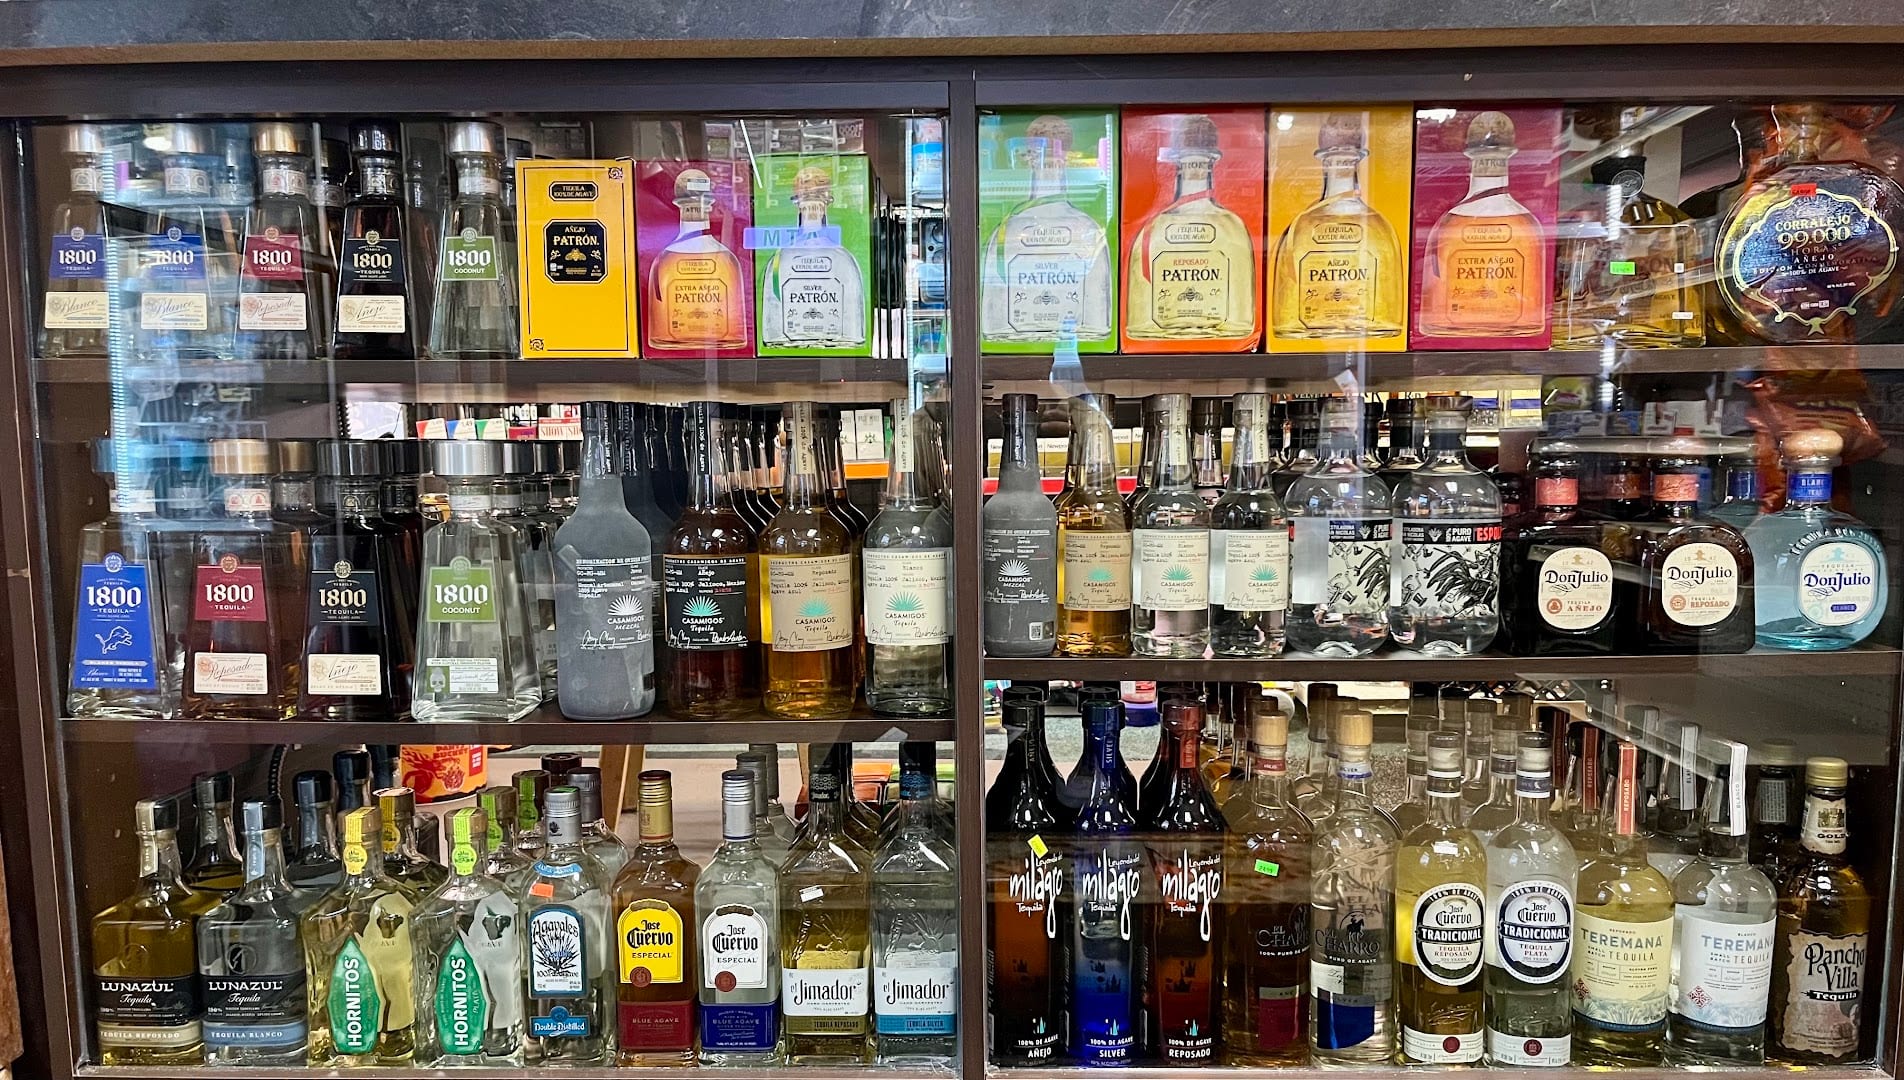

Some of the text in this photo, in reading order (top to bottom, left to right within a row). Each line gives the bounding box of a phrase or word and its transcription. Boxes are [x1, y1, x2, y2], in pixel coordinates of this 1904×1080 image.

[1775, 214, 1851, 232] CORRALEJO
[59, 249, 97, 265] 1800
[253, 249, 292, 265] 1800
[1791, 245, 1837, 256] HORAS
[353, 253, 392, 269] 1800
[448, 249, 490, 267] 1800
[1794, 253, 1835, 264] AÑEJO
[1452, 528, 1472, 536] PURO
[1452, 534, 1472, 543] AGAVE
[87, 586, 142, 607] 1800
[205, 583, 254, 603] 1800
[318, 588, 367, 607] 1800
[434, 584, 488, 604] 1800
[1567, 604, 1603, 612] AÑEJO
[1690, 600, 1730, 609] REPOSADO
[681, 616, 723, 625] CASAMIGOS
[795, 616, 835, 625] CASAMIGOS
[885, 612, 926, 620] CASAMIGOS
[893, 619, 917, 627] Tequila
[614, 623, 641, 632] MEZCAL
[690, 624, 714, 634] Tequila
[804, 625, 828, 633] Tequila
[1009, 849, 1063, 939] milagro
[1082, 848, 1140, 941] milagro
[1162, 848, 1221, 942] milagro
[1016, 902, 1044, 918] Tequila
[1088, 901, 1117, 918] Tequila
[1168, 901, 1197, 918] Tequila
[1449, 905, 1464, 914] Jose
[1531, 902, 1547, 912] Jose
[1435, 910, 1472, 927] Cuervo
[1518, 907, 1557, 923] Cuervo
[641, 919, 661, 932] Jose
[727, 924, 746, 937] Jose
[1503, 923, 1567, 939] TRADICIONAL
[626, 926, 674, 949] Cuervo
[1421, 927, 1482, 942] TRADICIONAL
[1580, 927, 1662, 950] TEREMANA
[712, 932, 759, 954] Cuervo
[1520, 943, 1553, 951] TEQUILA
[1609, 951, 1655, 962] TEQUILA
[1804, 942, 1865, 976] Pancho
[1817, 962, 1858, 991] Villa
[101, 980, 174, 992] LUNAZUL
[208, 981, 283, 991] LUNAZUL
[794, 977, 855, 1006] Jimador
[886, 977, 950, 1005] Jimador
[119, 993, 152, 1007] Tequila
[227, 992, 261, 1006] Tequila
[344, 957, 363, 1047] HORNITOS
[451, 957, 469, 1047] HORNITOS
[1813, 991, 1858, 1002] Tequila
[534, 1021, 585, 1032] Double Distilled
[1090, 1036, 1134, 1046] 100% DE AGAVE
[1168, 1038, 1185, 1046] 100%
[1195, 1037, 1213, 1046] AGAVE
[1027, 1046, 1052, 1058] AÑEJO
[1099, 1048, 1126, 1058] SILVER
[1169, 1048, 1211, 1058] REPOSADO
